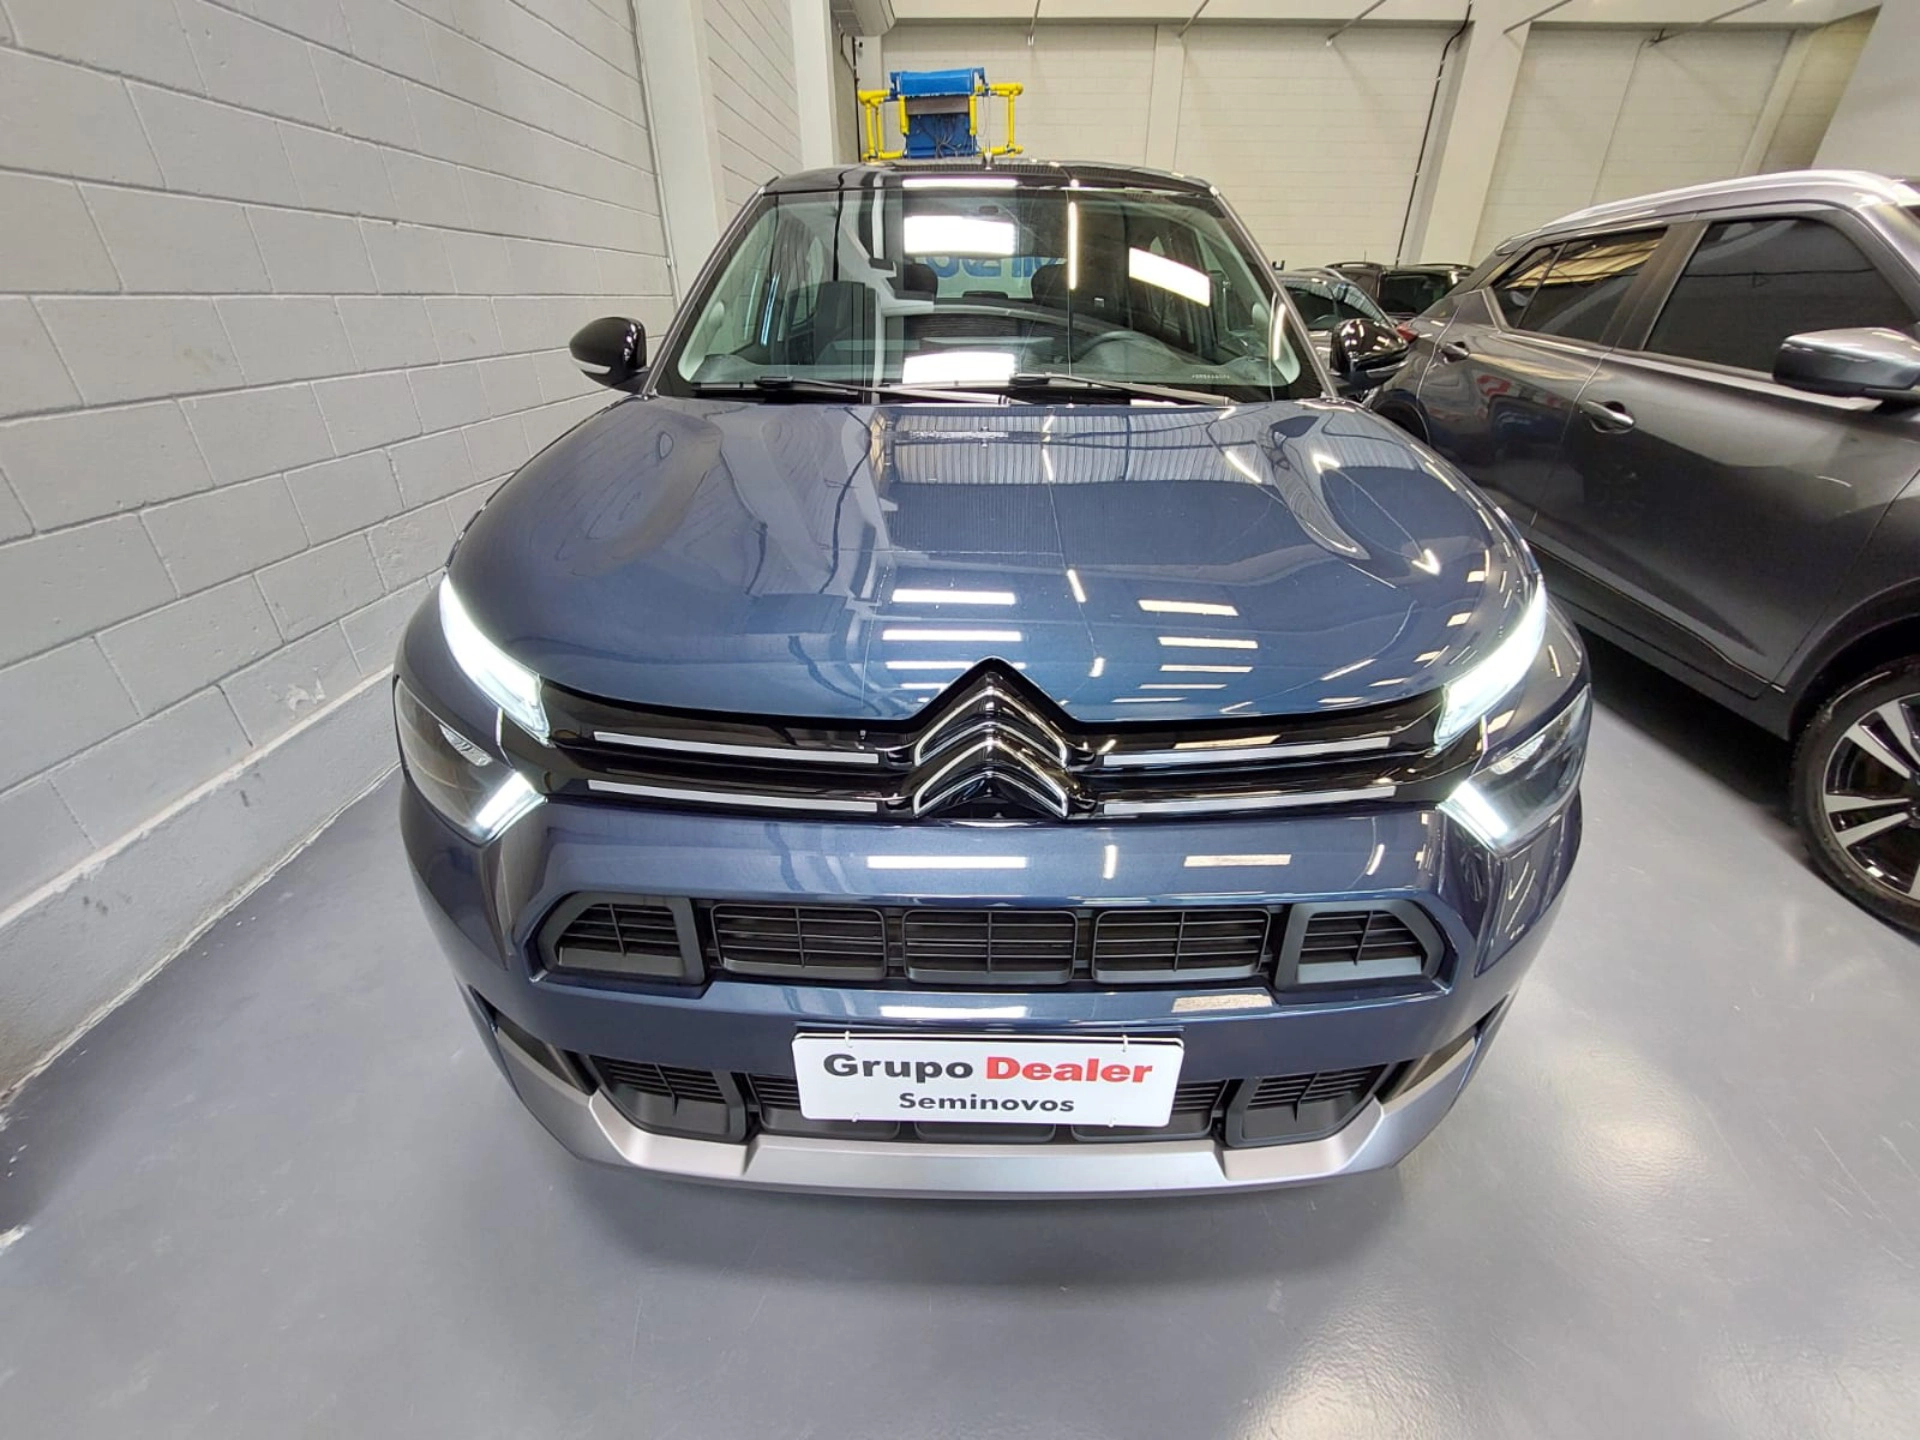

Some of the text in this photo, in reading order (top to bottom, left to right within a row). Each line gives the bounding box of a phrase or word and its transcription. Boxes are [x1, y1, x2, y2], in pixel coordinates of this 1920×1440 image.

[823, 1053, 1153, 1084] Grupo Dealer
[899, 1092, 1074, 1112] Seminovos
